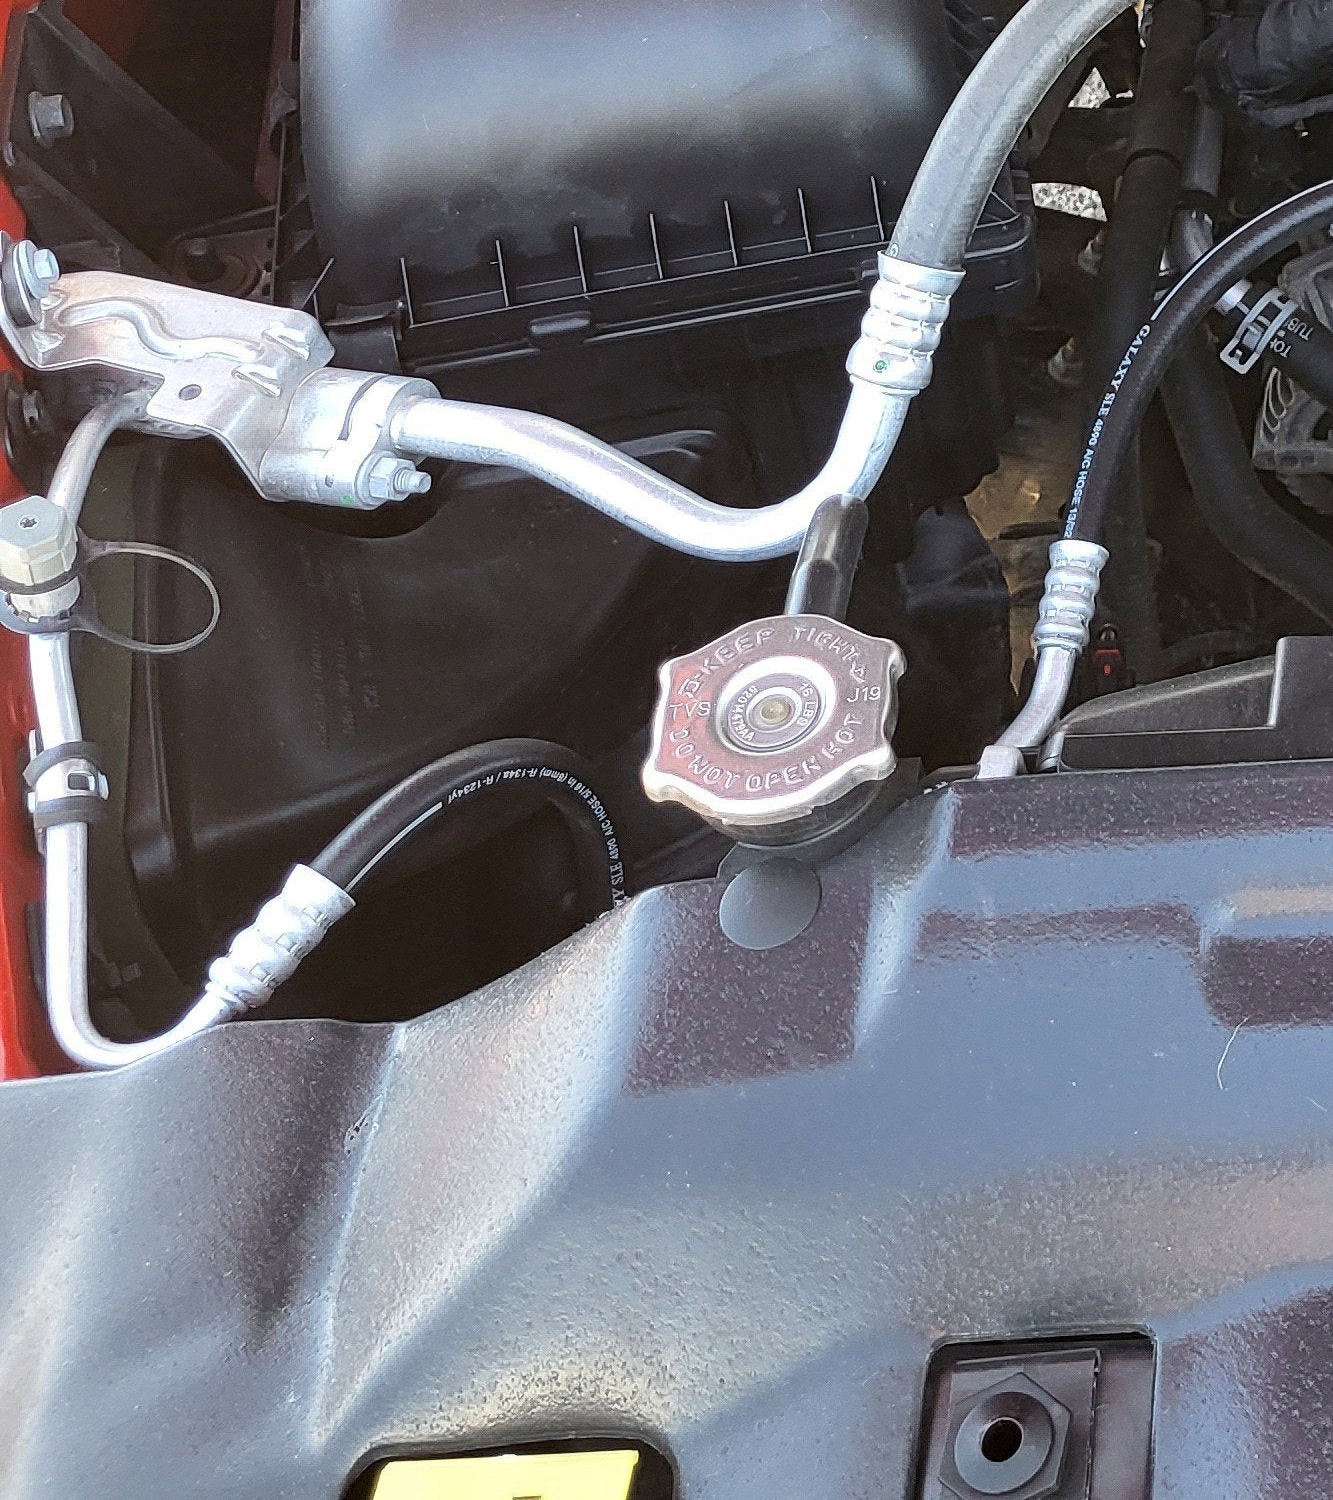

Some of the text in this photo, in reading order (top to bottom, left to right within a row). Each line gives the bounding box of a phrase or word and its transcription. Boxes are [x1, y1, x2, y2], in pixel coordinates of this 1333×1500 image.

[1111, 324, 1151, 392] GALAXY
[1071, 471, 1088, 506] HOSE
[702, 627, 776, 676] KEEP
[846, 685, 882, 704] J19
[669, 700, 712, 720] TVS
[587, 796, 608, 821] HOSE
